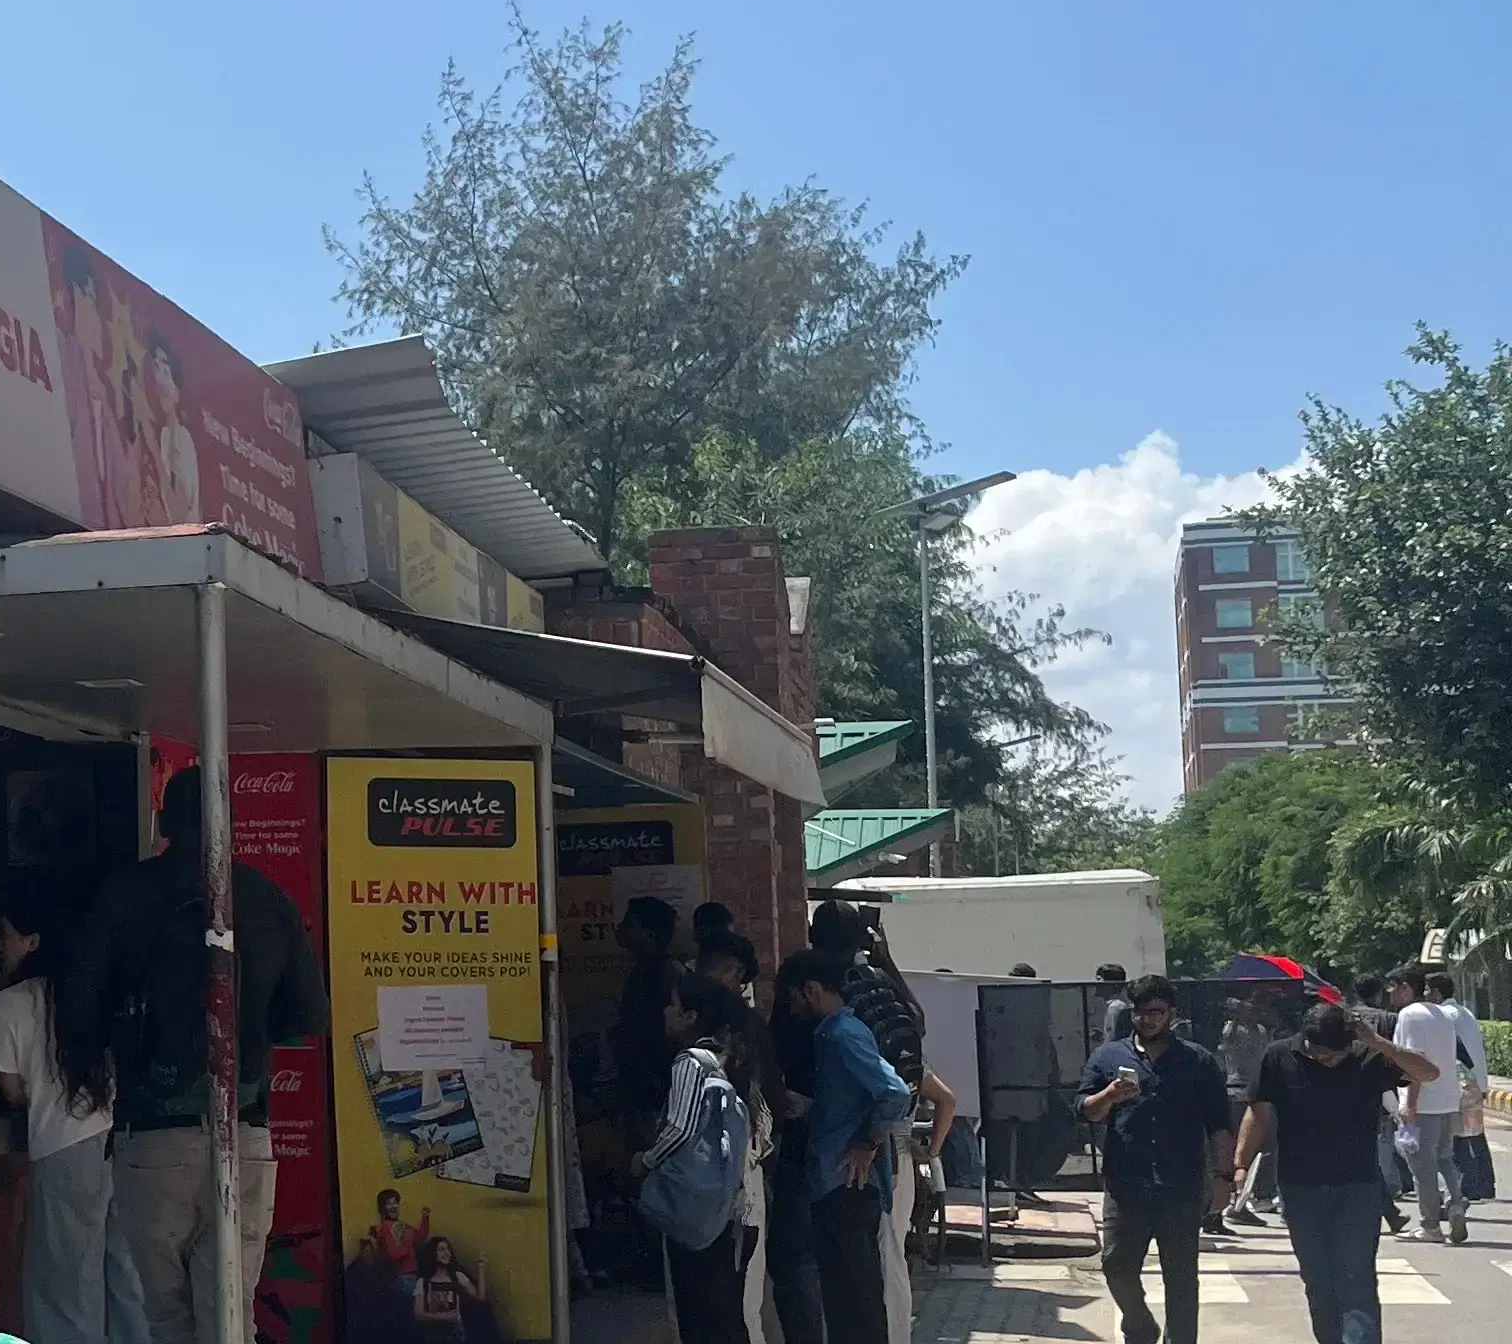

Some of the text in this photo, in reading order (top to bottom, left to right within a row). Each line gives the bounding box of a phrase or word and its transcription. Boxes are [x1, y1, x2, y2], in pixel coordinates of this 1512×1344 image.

[219, 462, 249, 503] Time
[400, 817, 505, 836] PULSE
[234, 832, 299, 840] Time for some
[232, 842, 304, 857] Coke Magic
[351, 880, 537, 905] LEARN WITH
[402, 911, 490, 935] STYLE
[361, 952, 532, 964] MAKE YOUR IDEAS SHINE
[363, 966, 531, 978] AND YOUR COVERS POP!
[274, 1143, 311, 1157] Magic
